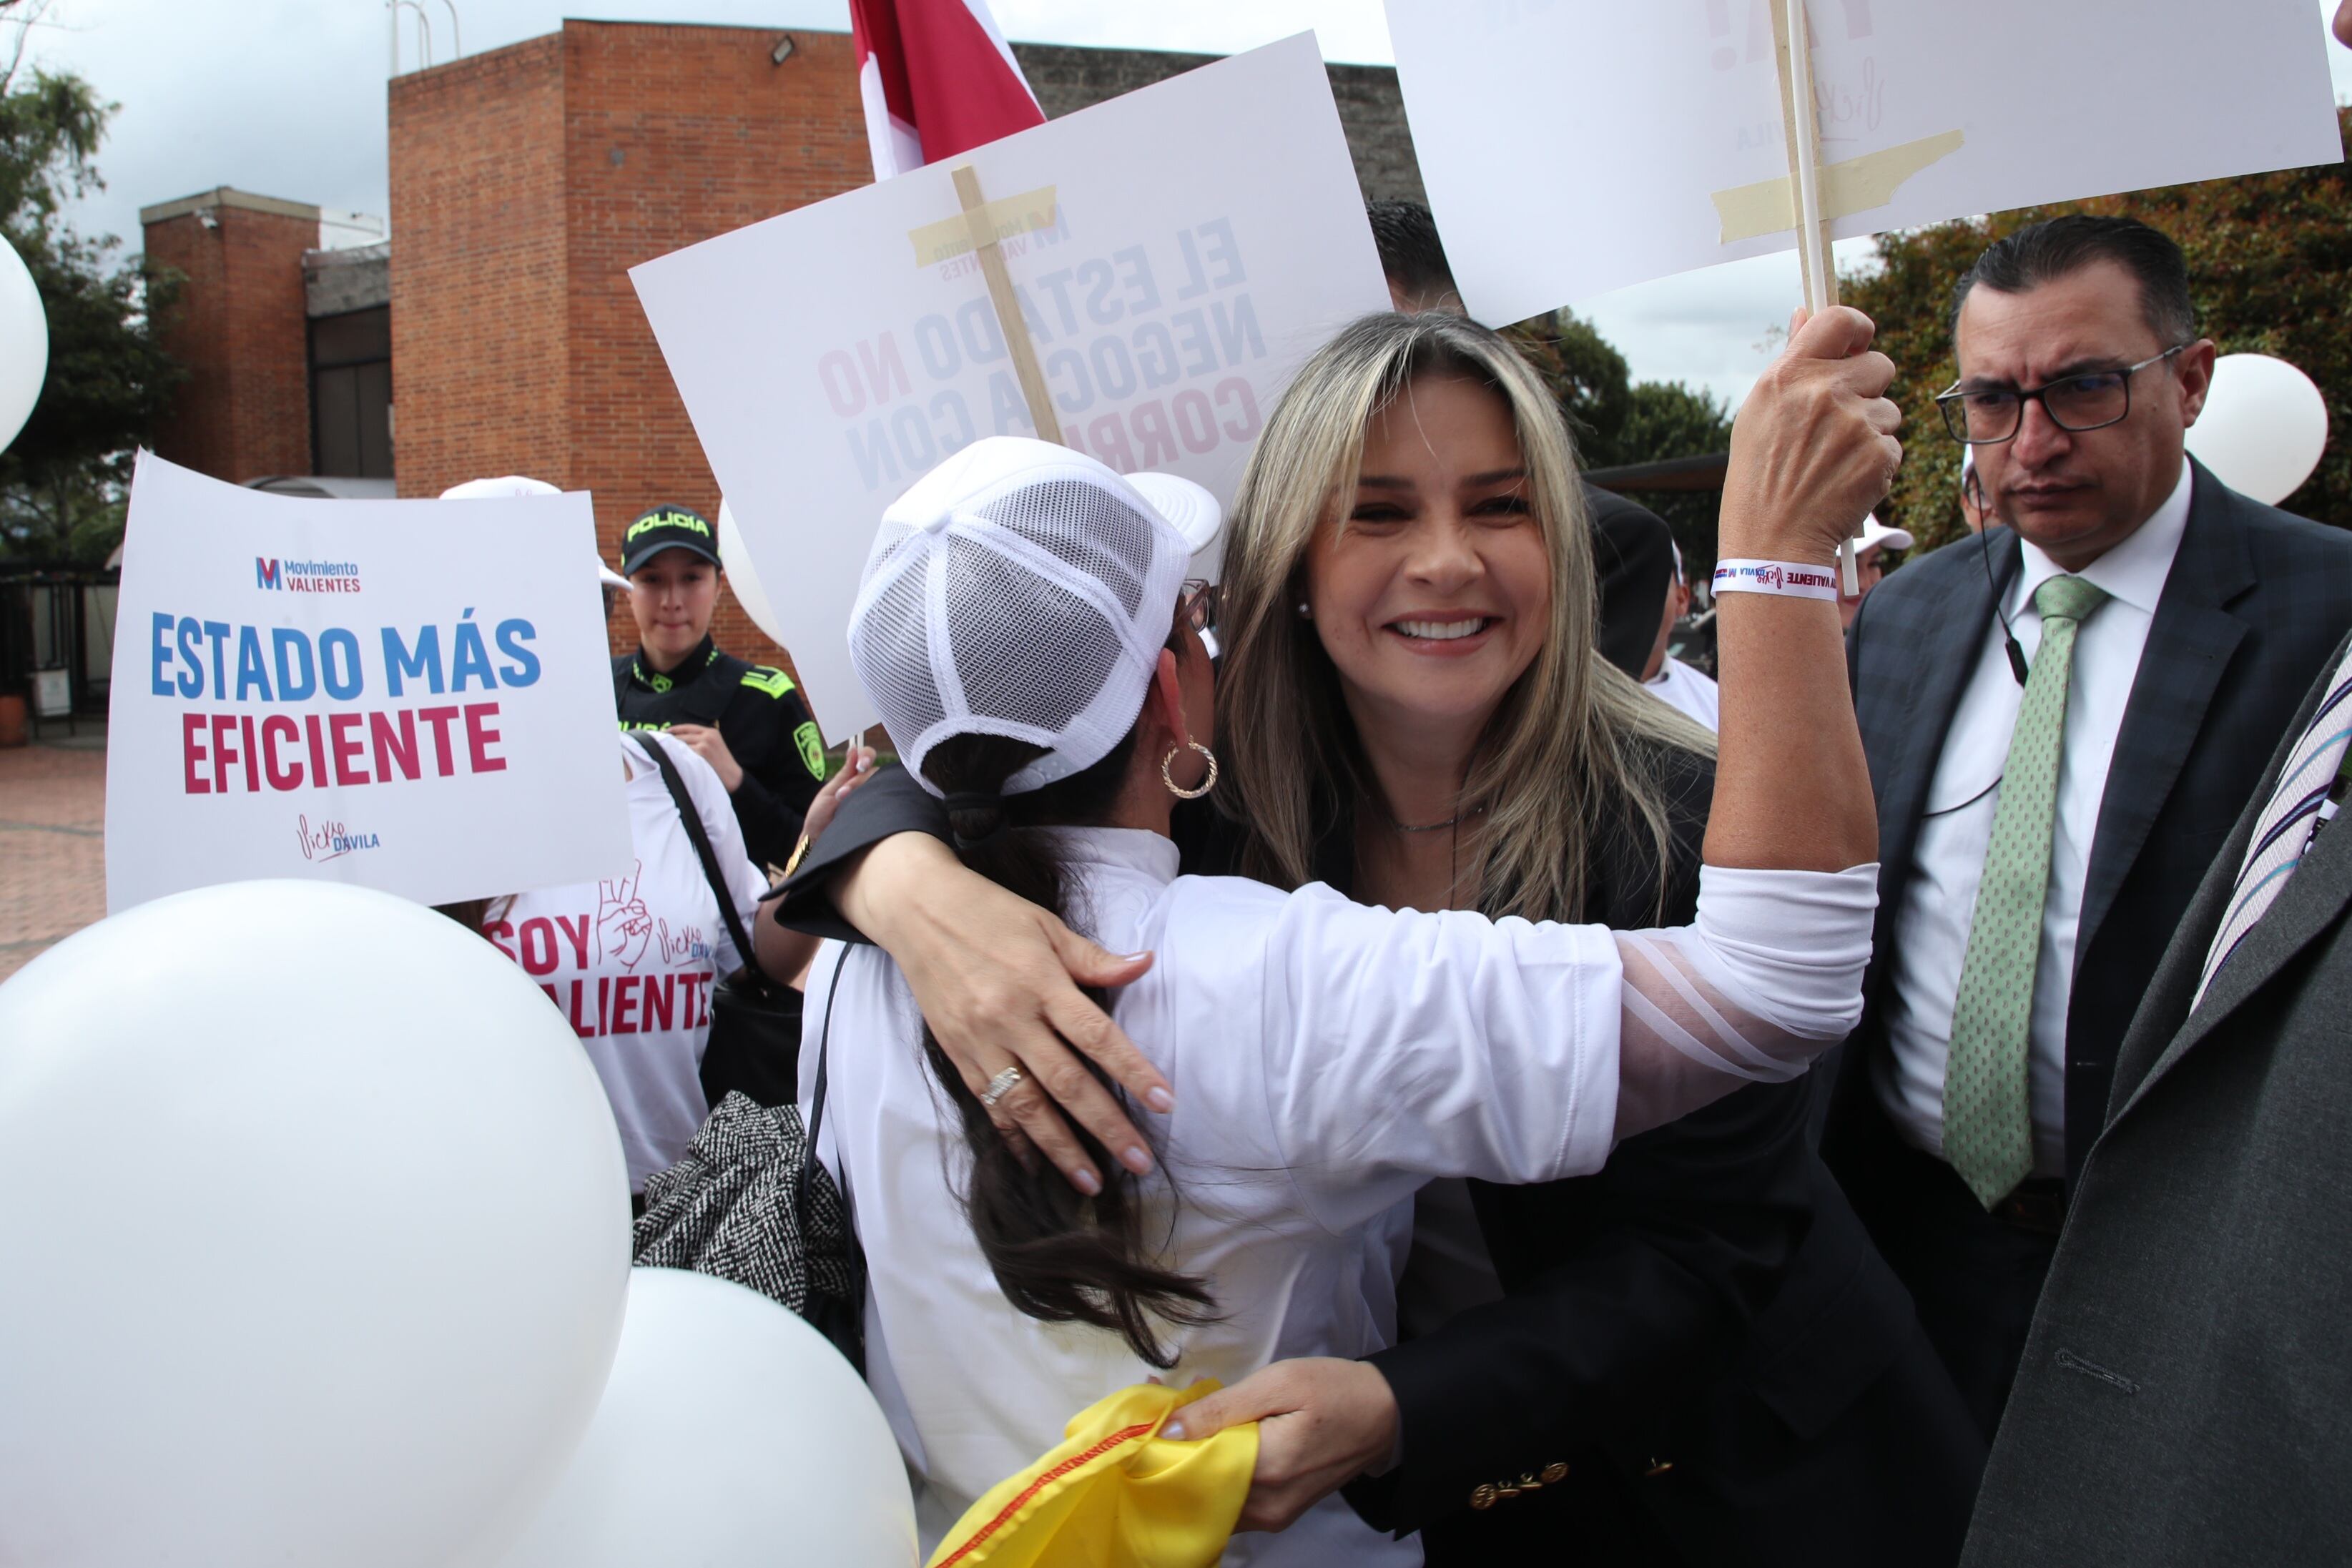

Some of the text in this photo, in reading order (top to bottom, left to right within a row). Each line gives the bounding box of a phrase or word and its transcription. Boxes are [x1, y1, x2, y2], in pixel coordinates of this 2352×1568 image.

[284, 560, 358, 576] Movimiento
[287, 577, 360, 593] VALIENTES
[1787, 572, 1830, 588] VALIENTE
[152, 607, 541, 701] ESTADO MÁS
[182, 702, 507, 794] EFICIENTE
